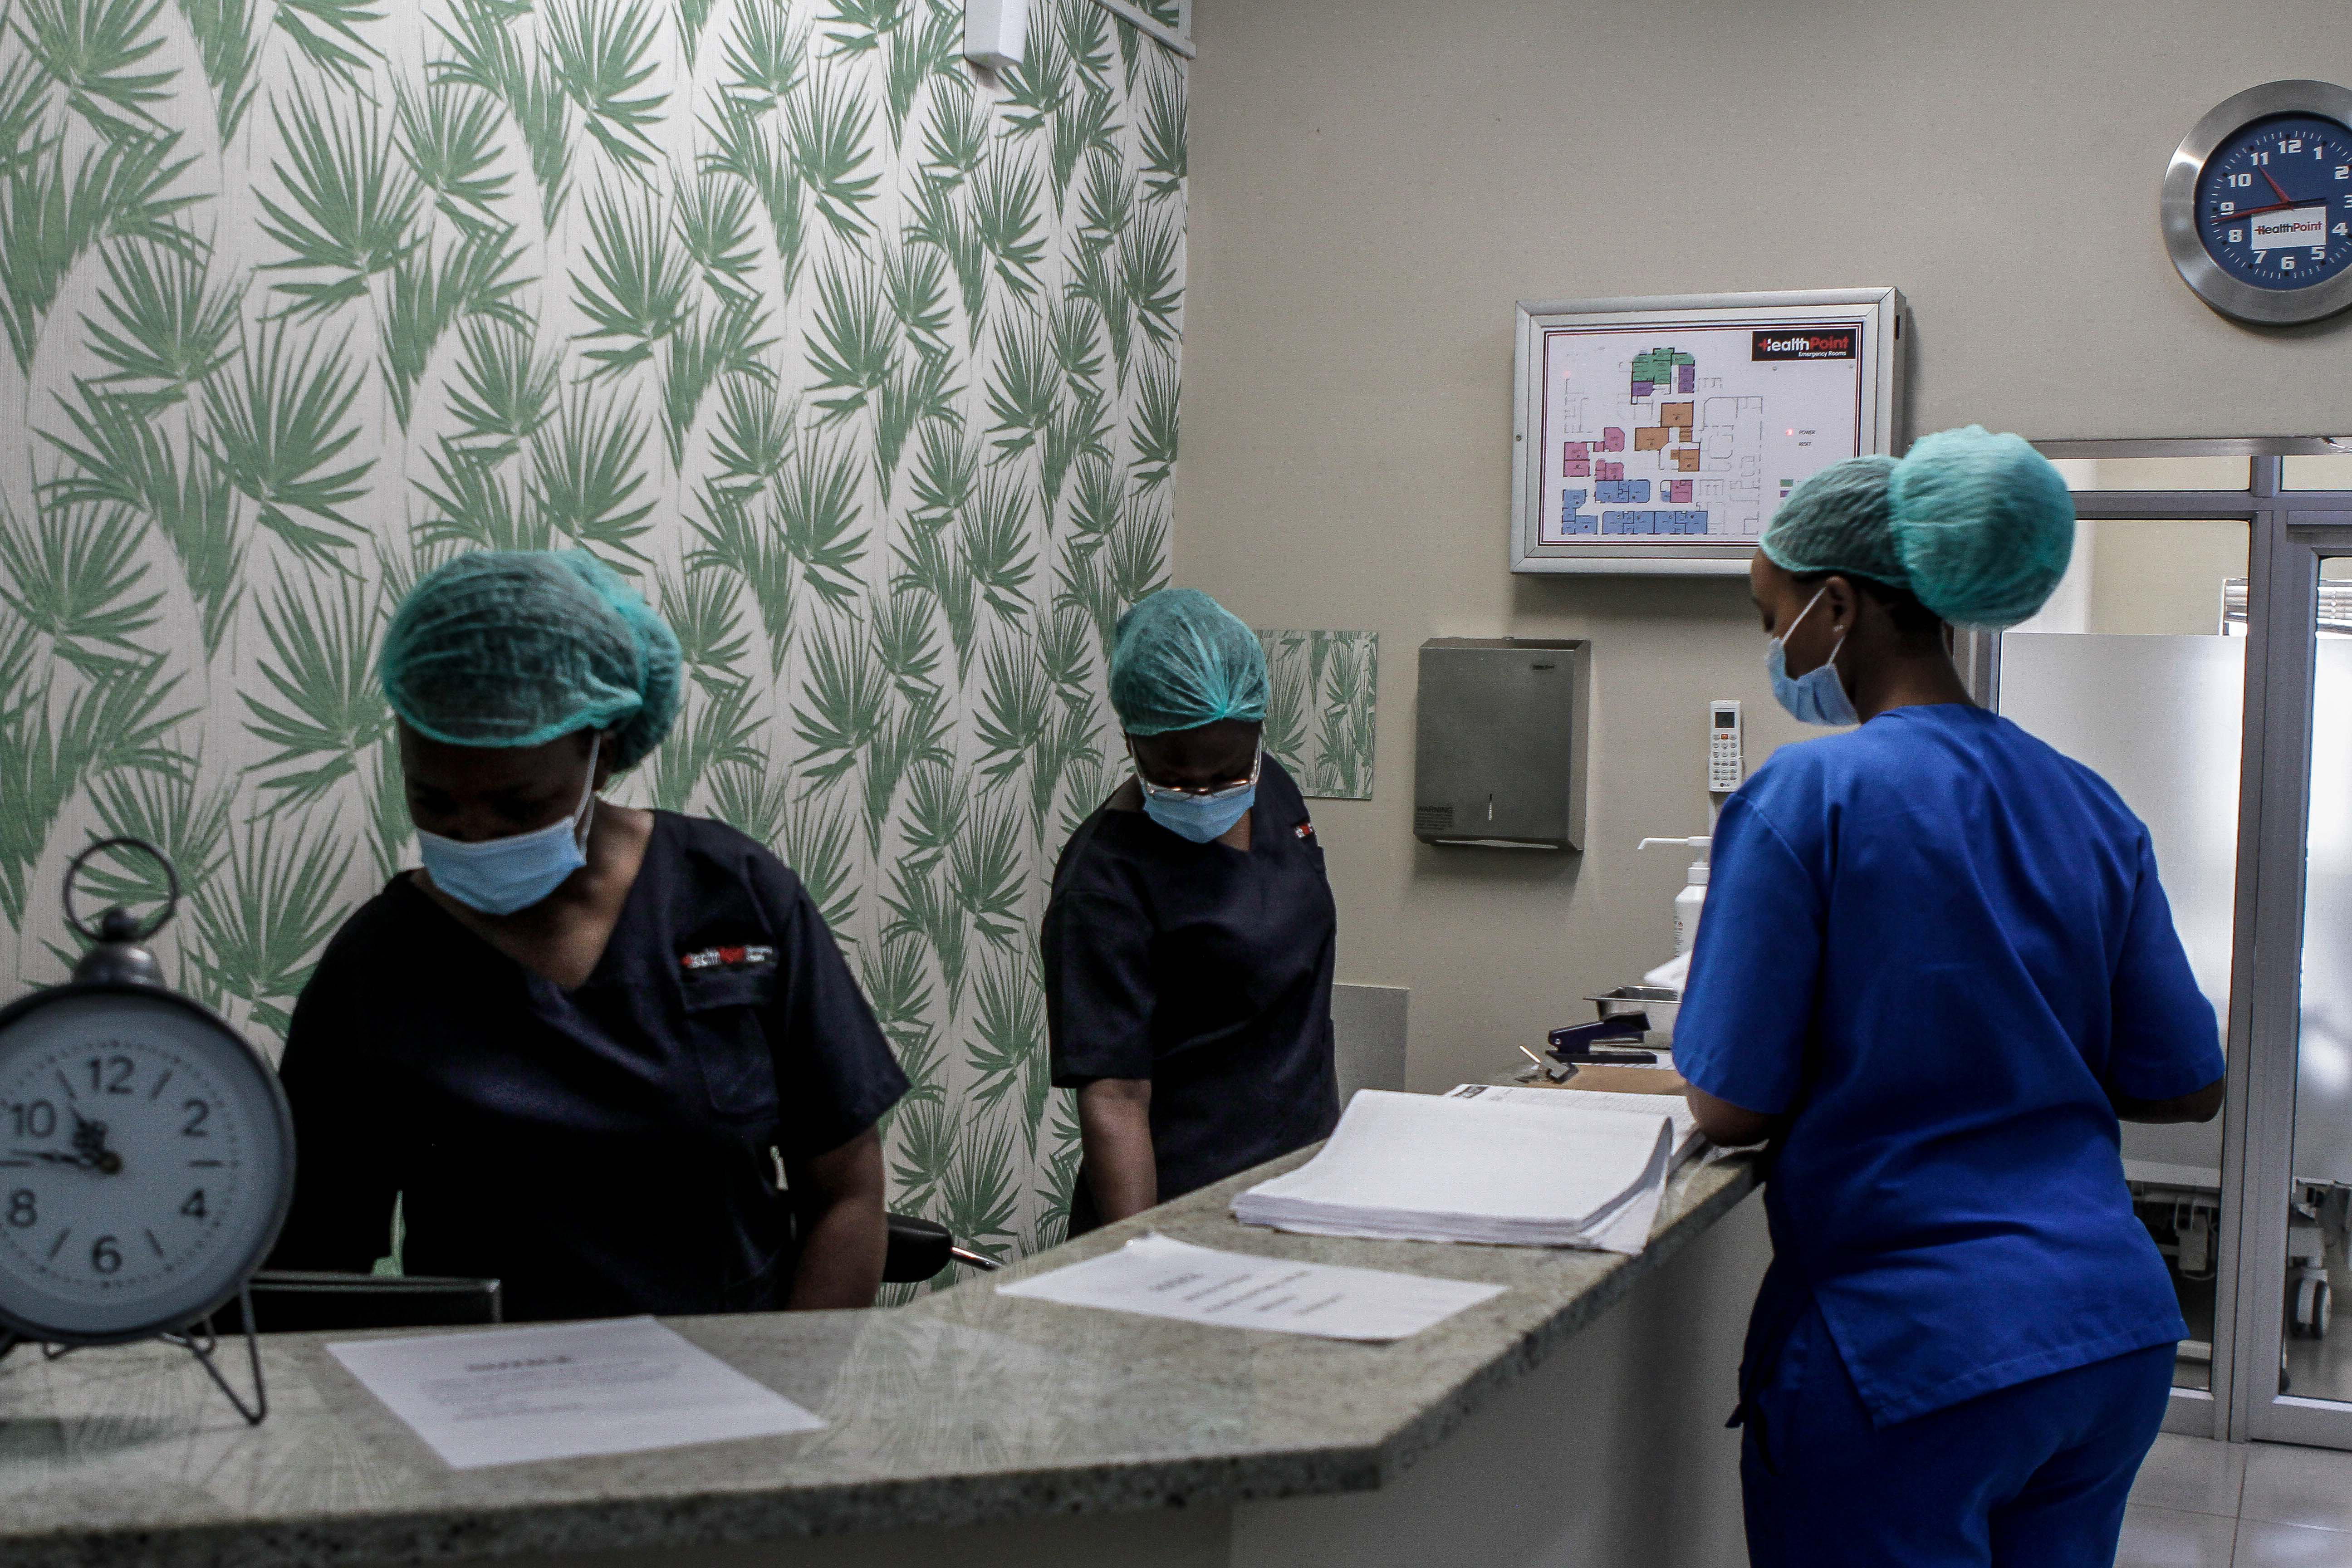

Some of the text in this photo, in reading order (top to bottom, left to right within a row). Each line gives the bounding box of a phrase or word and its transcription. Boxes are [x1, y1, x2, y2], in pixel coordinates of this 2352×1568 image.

[2278, 139, 2301, 154] 12
[2313, 146, 2323, 160] 1
[2250, 152, 2268, 166] 11
[2335, 166, 2350, 180] 2
[2228, 173, 2252, 188] 10
[2220, 202, 2234, 215] 9
[2254, 221, 2322, 235] HealthPoint
[2332, 222, 2349, 236] 4
[2228, 229, 2243, 243] 8
[2254, 250, 2267, 264] 7
[2311, 246, 2325, 260] 5
[2281, 256, 2295, 270] 6
[1758, 335, 1849, 352] HealthPoint
[1416, 806, 1453, 814] WARNING
[87, 1056, 134, 1093] 12
[11, 1099, 57, 1138] 10
[183, 1099, 210, 1136] 2
[8, 1187, 37, 1227] 8
[181, 1187, 207, 1219] 4
[92, 1235, 122, 1274] 6
